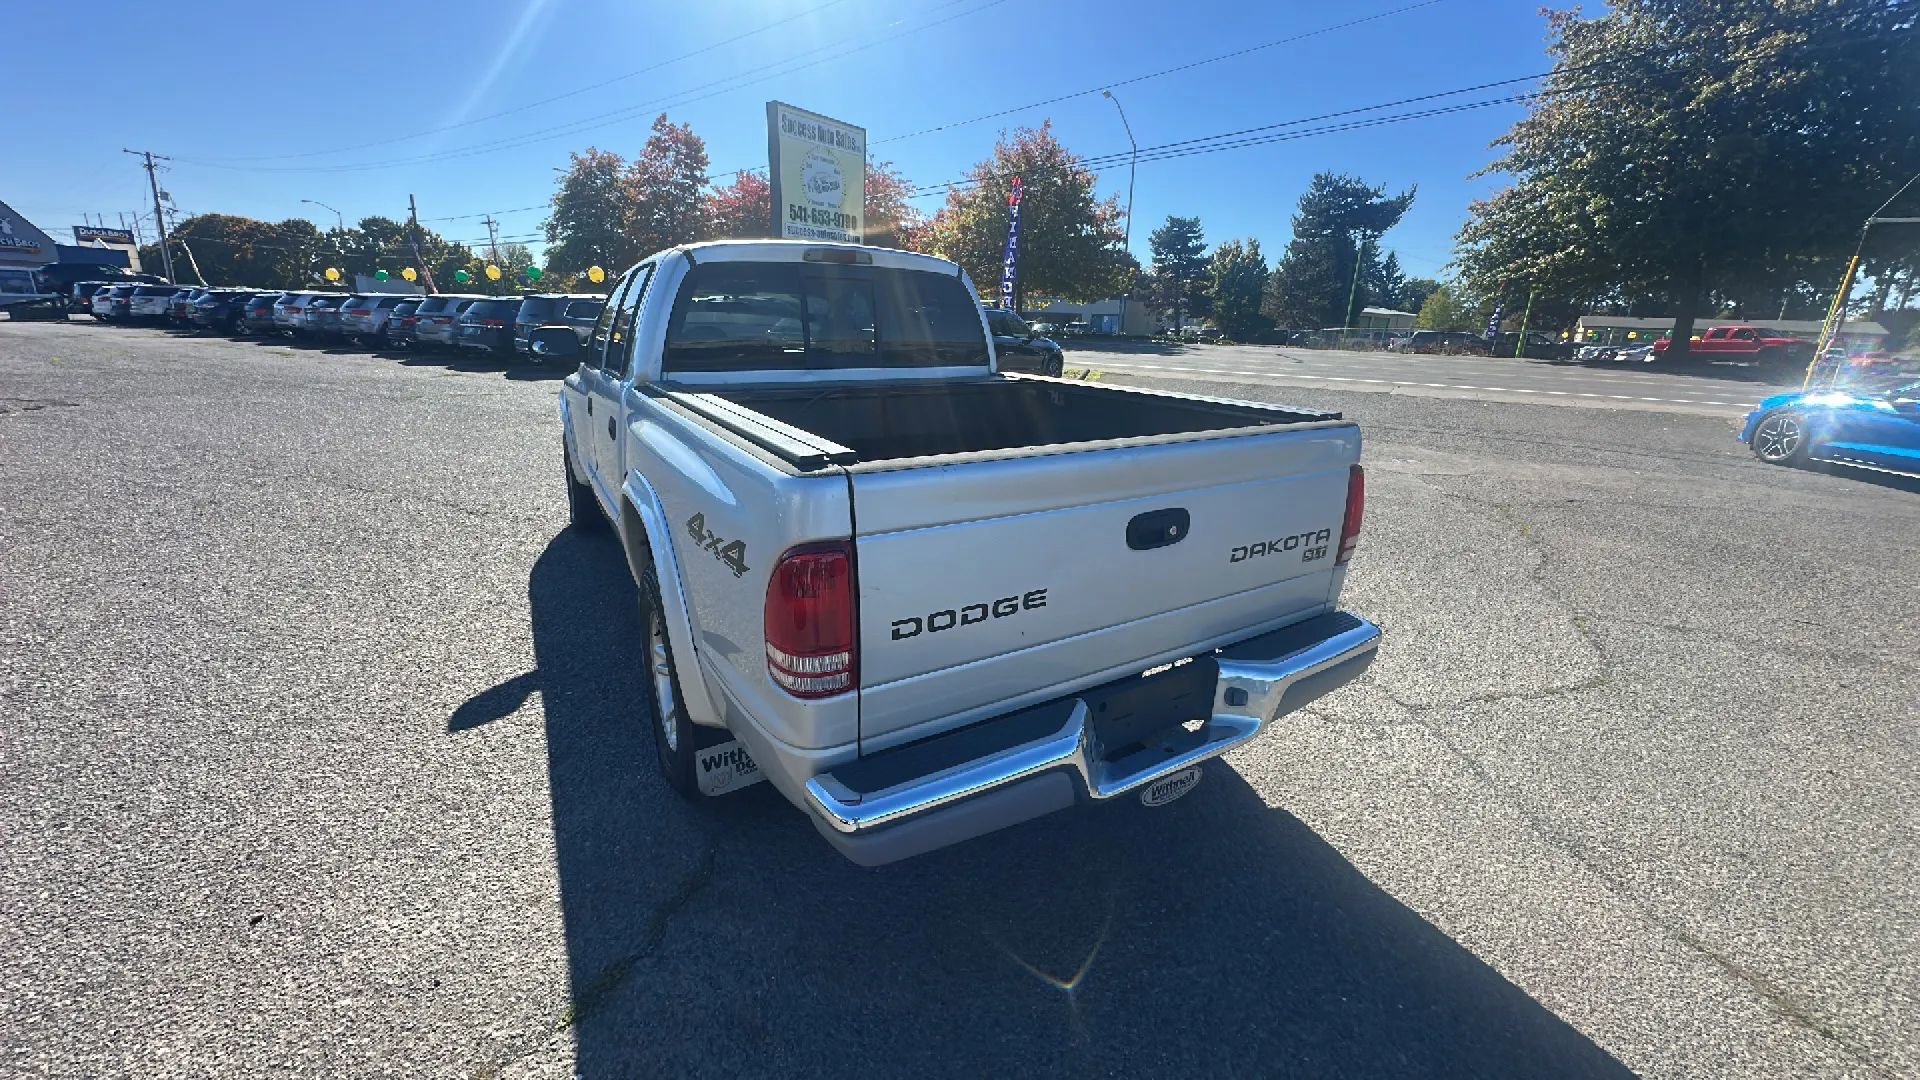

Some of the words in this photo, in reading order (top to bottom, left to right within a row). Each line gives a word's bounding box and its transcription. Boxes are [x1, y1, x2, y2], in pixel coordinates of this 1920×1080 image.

[782, 113, 816, 141] Success
[817, 124, 835, 145] Auto
[835, 129, 857, 151] Sales
[686, 512, 751, 578] 4x4
[1230, 528, 1331, 564] DAKOTA
[891, 588, 1048, 641] DODGE
[701, 747, 750, 773] With
